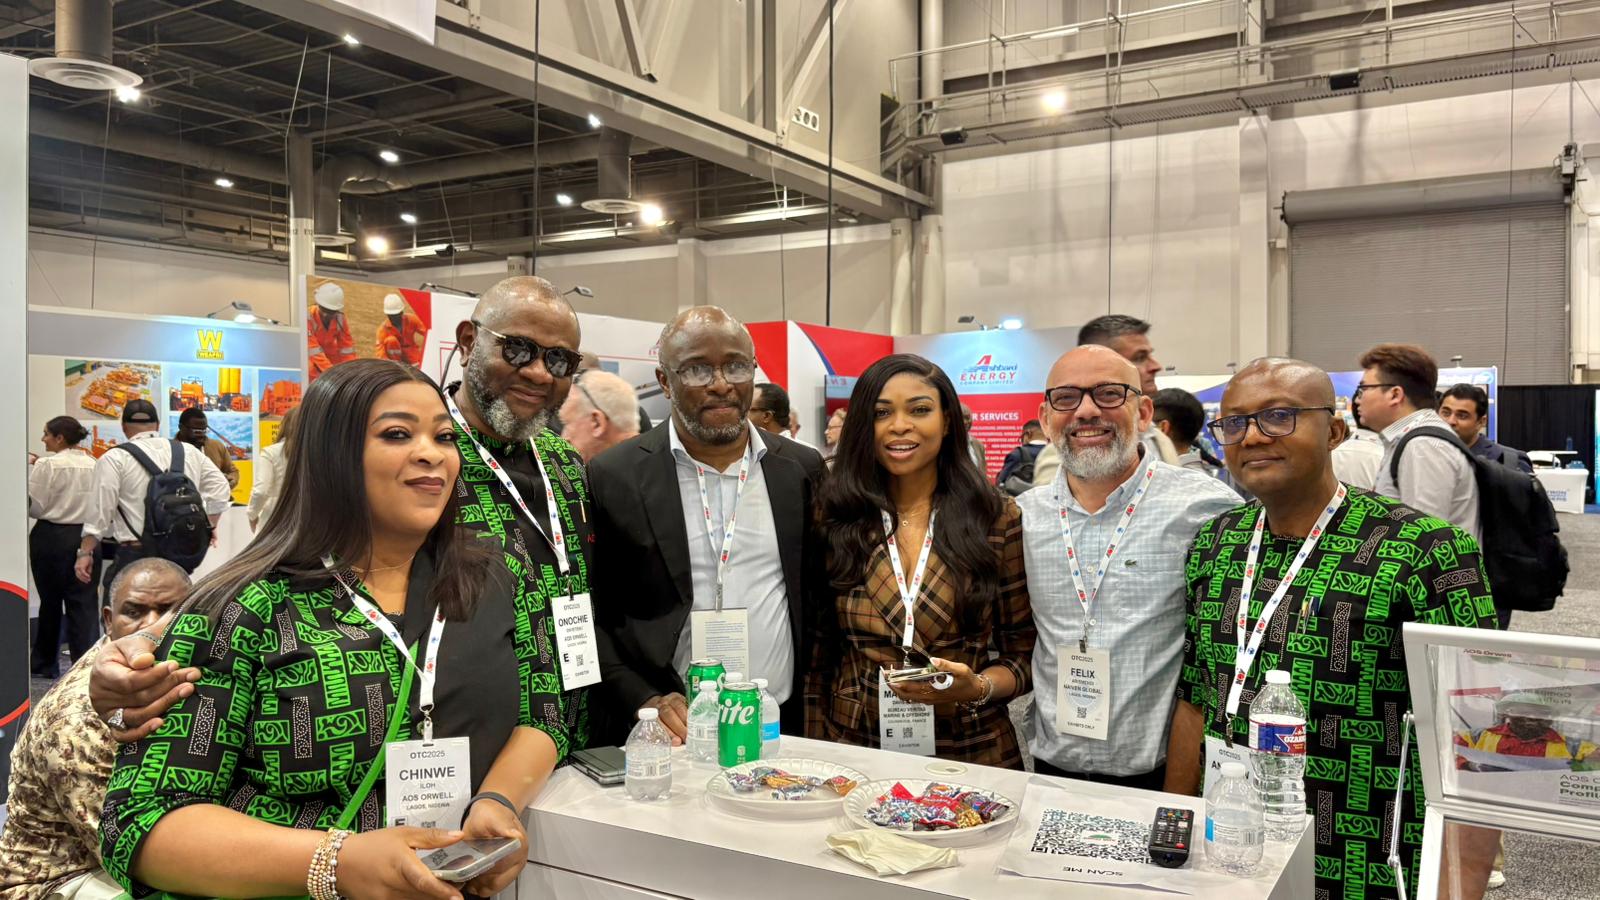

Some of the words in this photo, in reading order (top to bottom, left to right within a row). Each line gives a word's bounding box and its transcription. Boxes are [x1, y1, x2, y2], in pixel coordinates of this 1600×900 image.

[960, 372, 1016, 381] ENERGY
[980, 412, 1019, 421] SERVICES
[558, 614, 588, 626] ONOCHIE
[563, 653, 570, 663] E
[1071, 668, 1095, 679] FELIX
[1236, 667, 1246, 685] NOV
[1082, 687, 1103, 695] GLOBAL
[886, 728, 894, 738] E
[410, 750, 446, 759] OTC2025
[399, 766, 456, 781] CHINWE
[1560, 774, 1589, 783] AOS
[402, 794, 418, 802] AOS
[420, 791, 454, 801] ORWELL
[1087, 868, 1124, 877] SCAN
